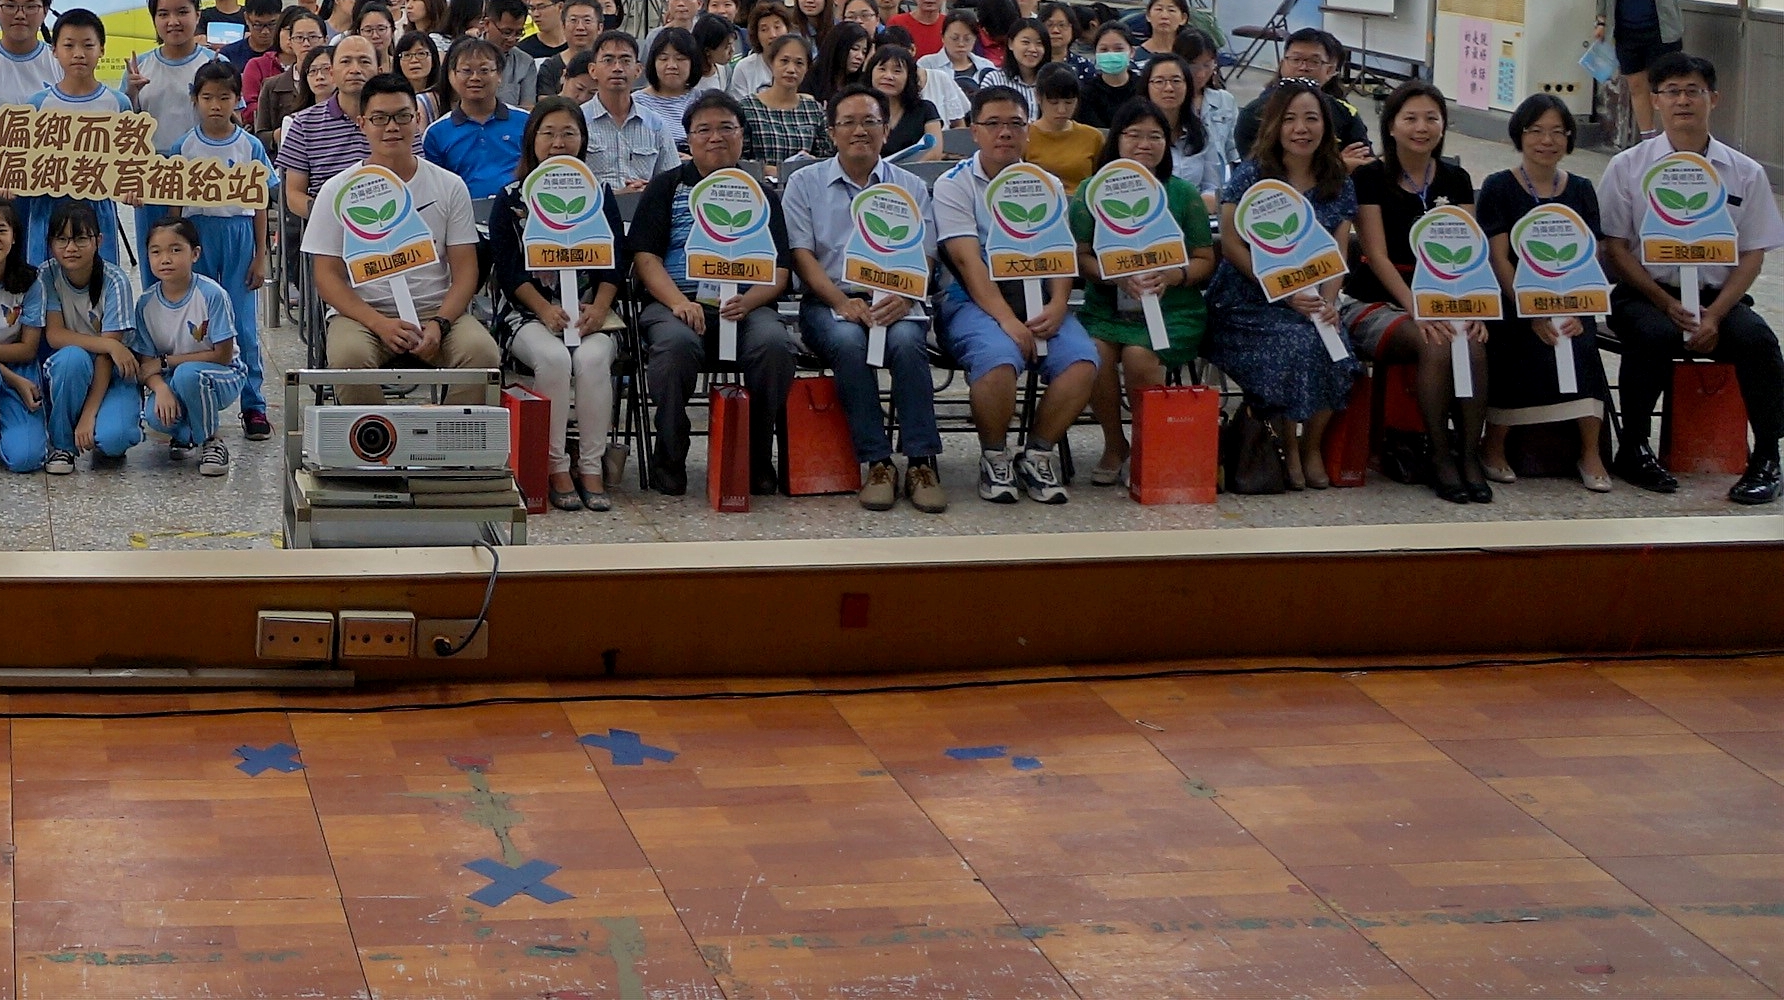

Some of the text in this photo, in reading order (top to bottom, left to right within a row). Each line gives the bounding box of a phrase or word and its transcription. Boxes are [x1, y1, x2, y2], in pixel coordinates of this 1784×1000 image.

[542, 248, 599, 263] 竹橋國小
[1659, 245, 1722, 260] 三股國小
[363, 249, 422, 276] 龍山國小
[702, 260, 760, 277] 七股國小
[1006, 257, 1063, 273] 大文國小
[1534, 295, 1594, 310] 樹林國小
